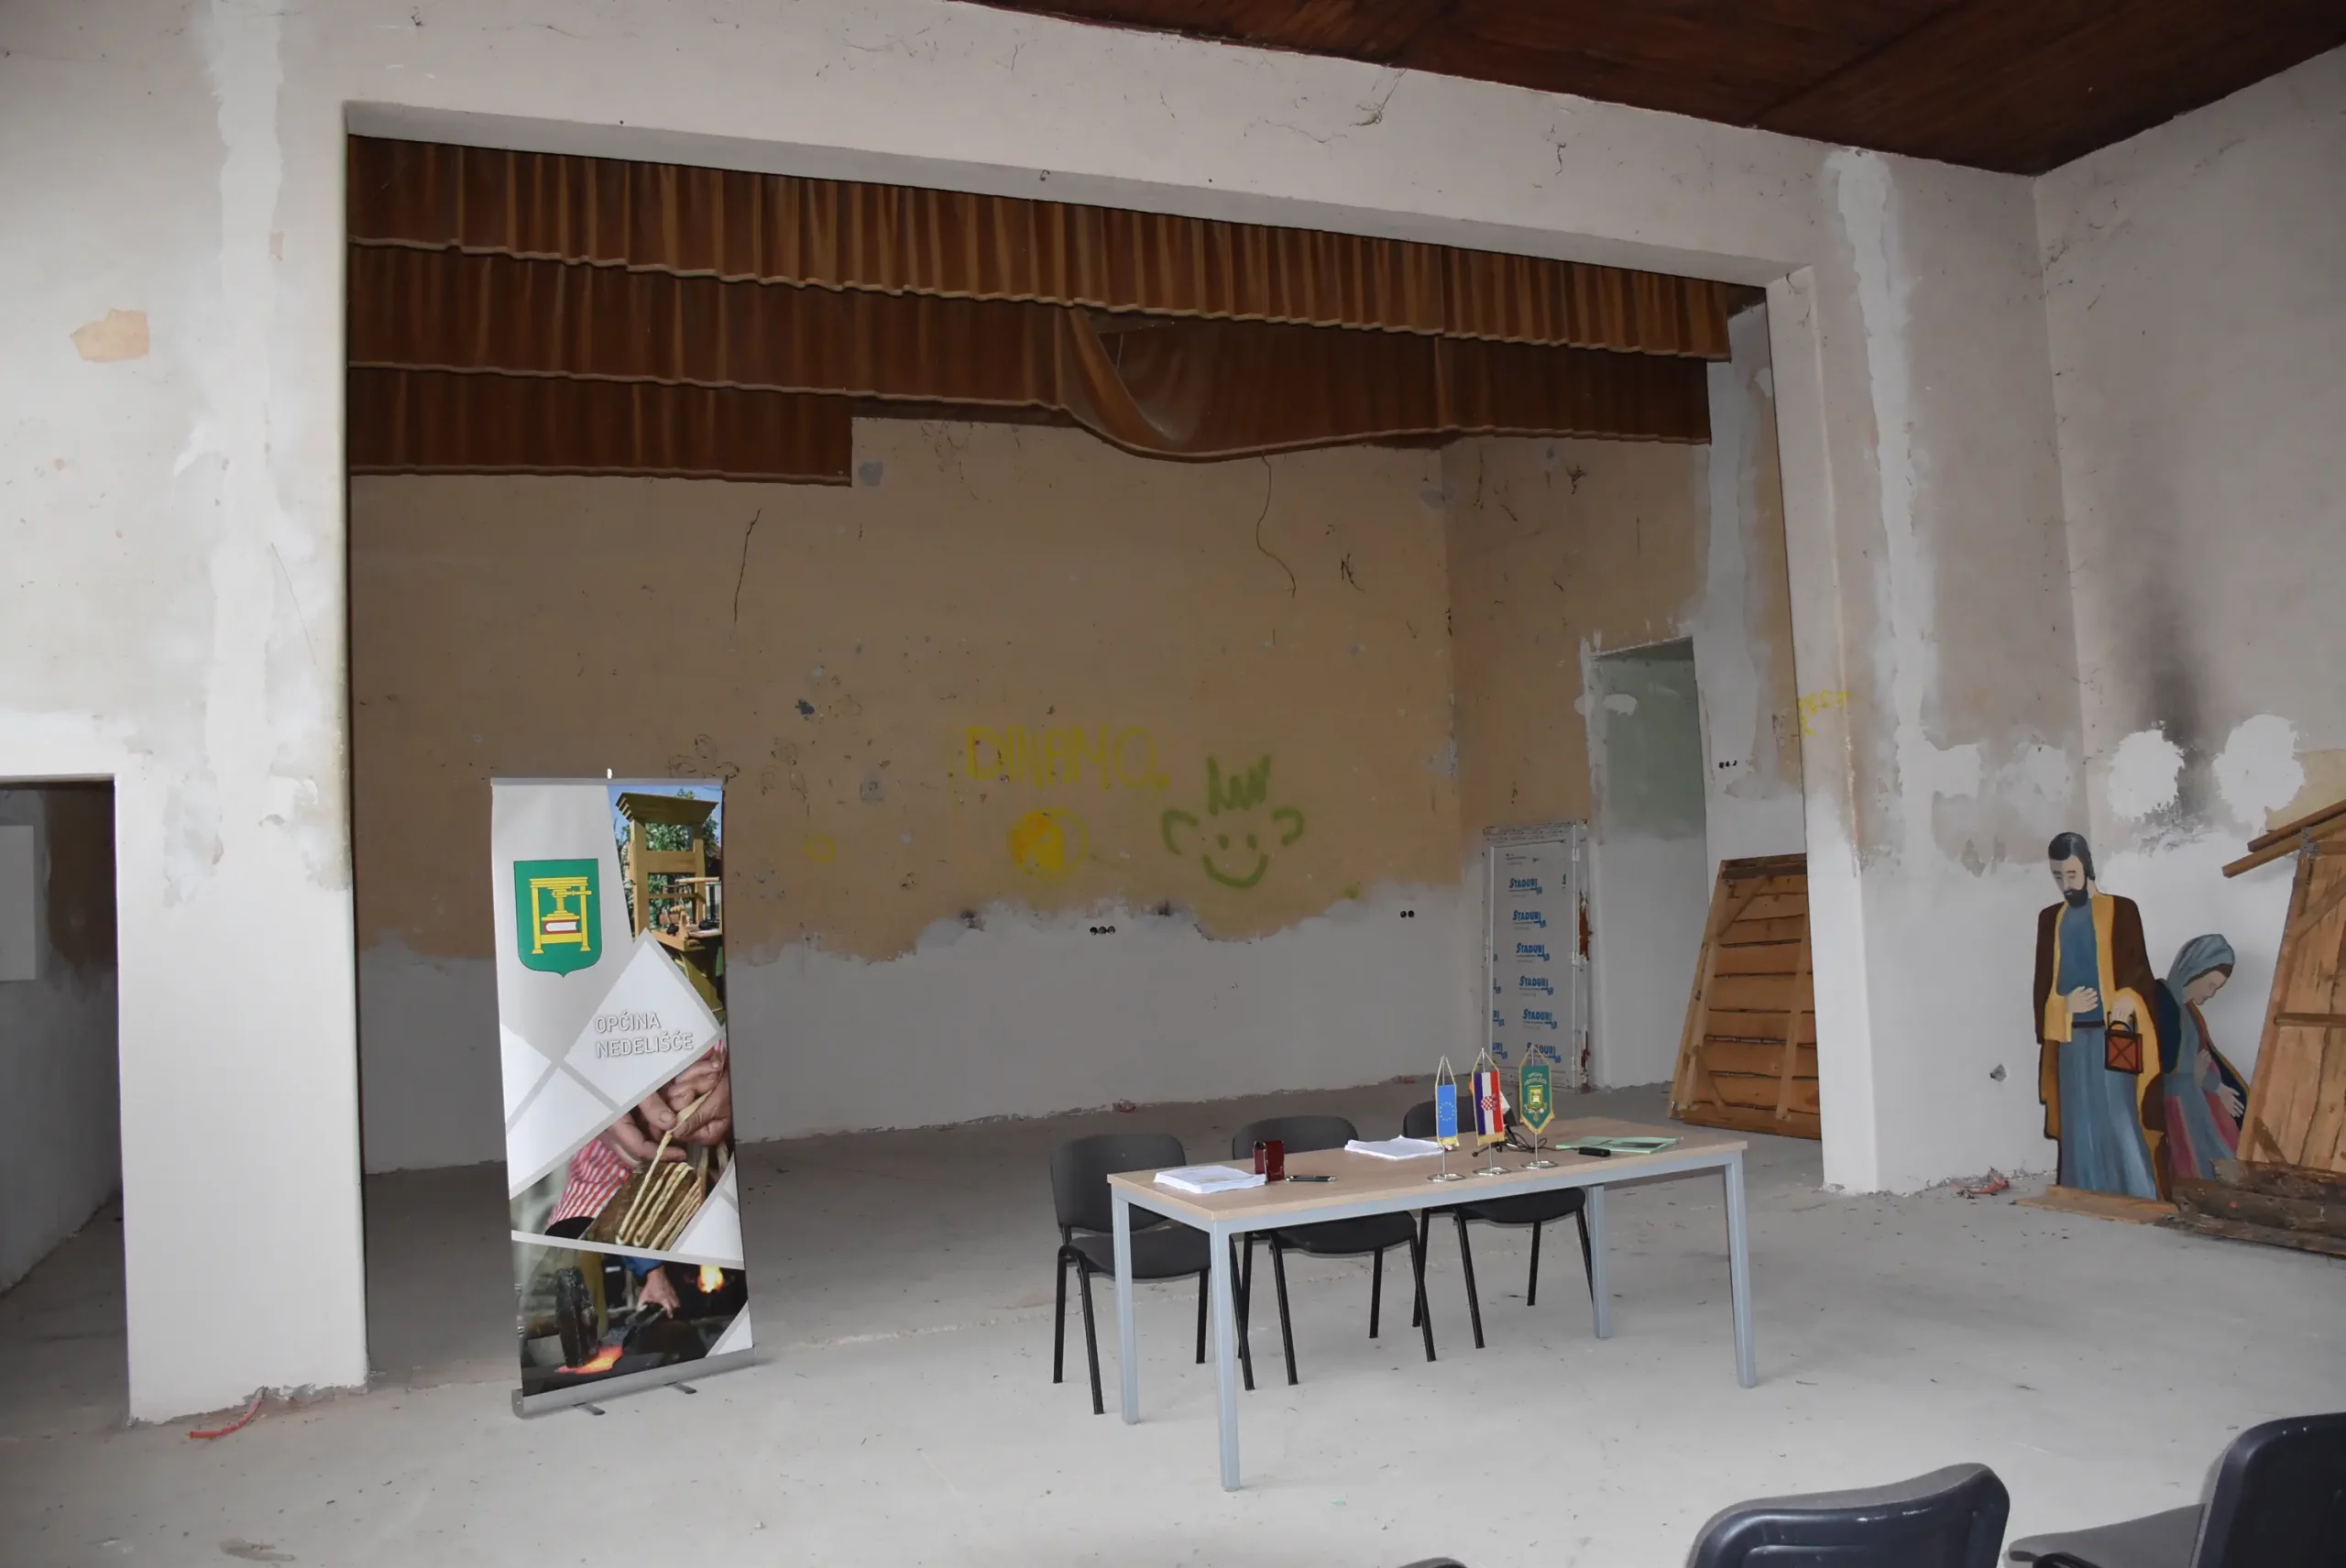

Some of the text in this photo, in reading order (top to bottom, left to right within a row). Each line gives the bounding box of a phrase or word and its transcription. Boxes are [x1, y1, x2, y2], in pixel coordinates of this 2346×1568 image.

[964, 724, 1157, 789] DINAMO
[596, 1011, 661, 1034] OPĆINA
[597, 1030, 694, 1058] NEDELIŠĆE
